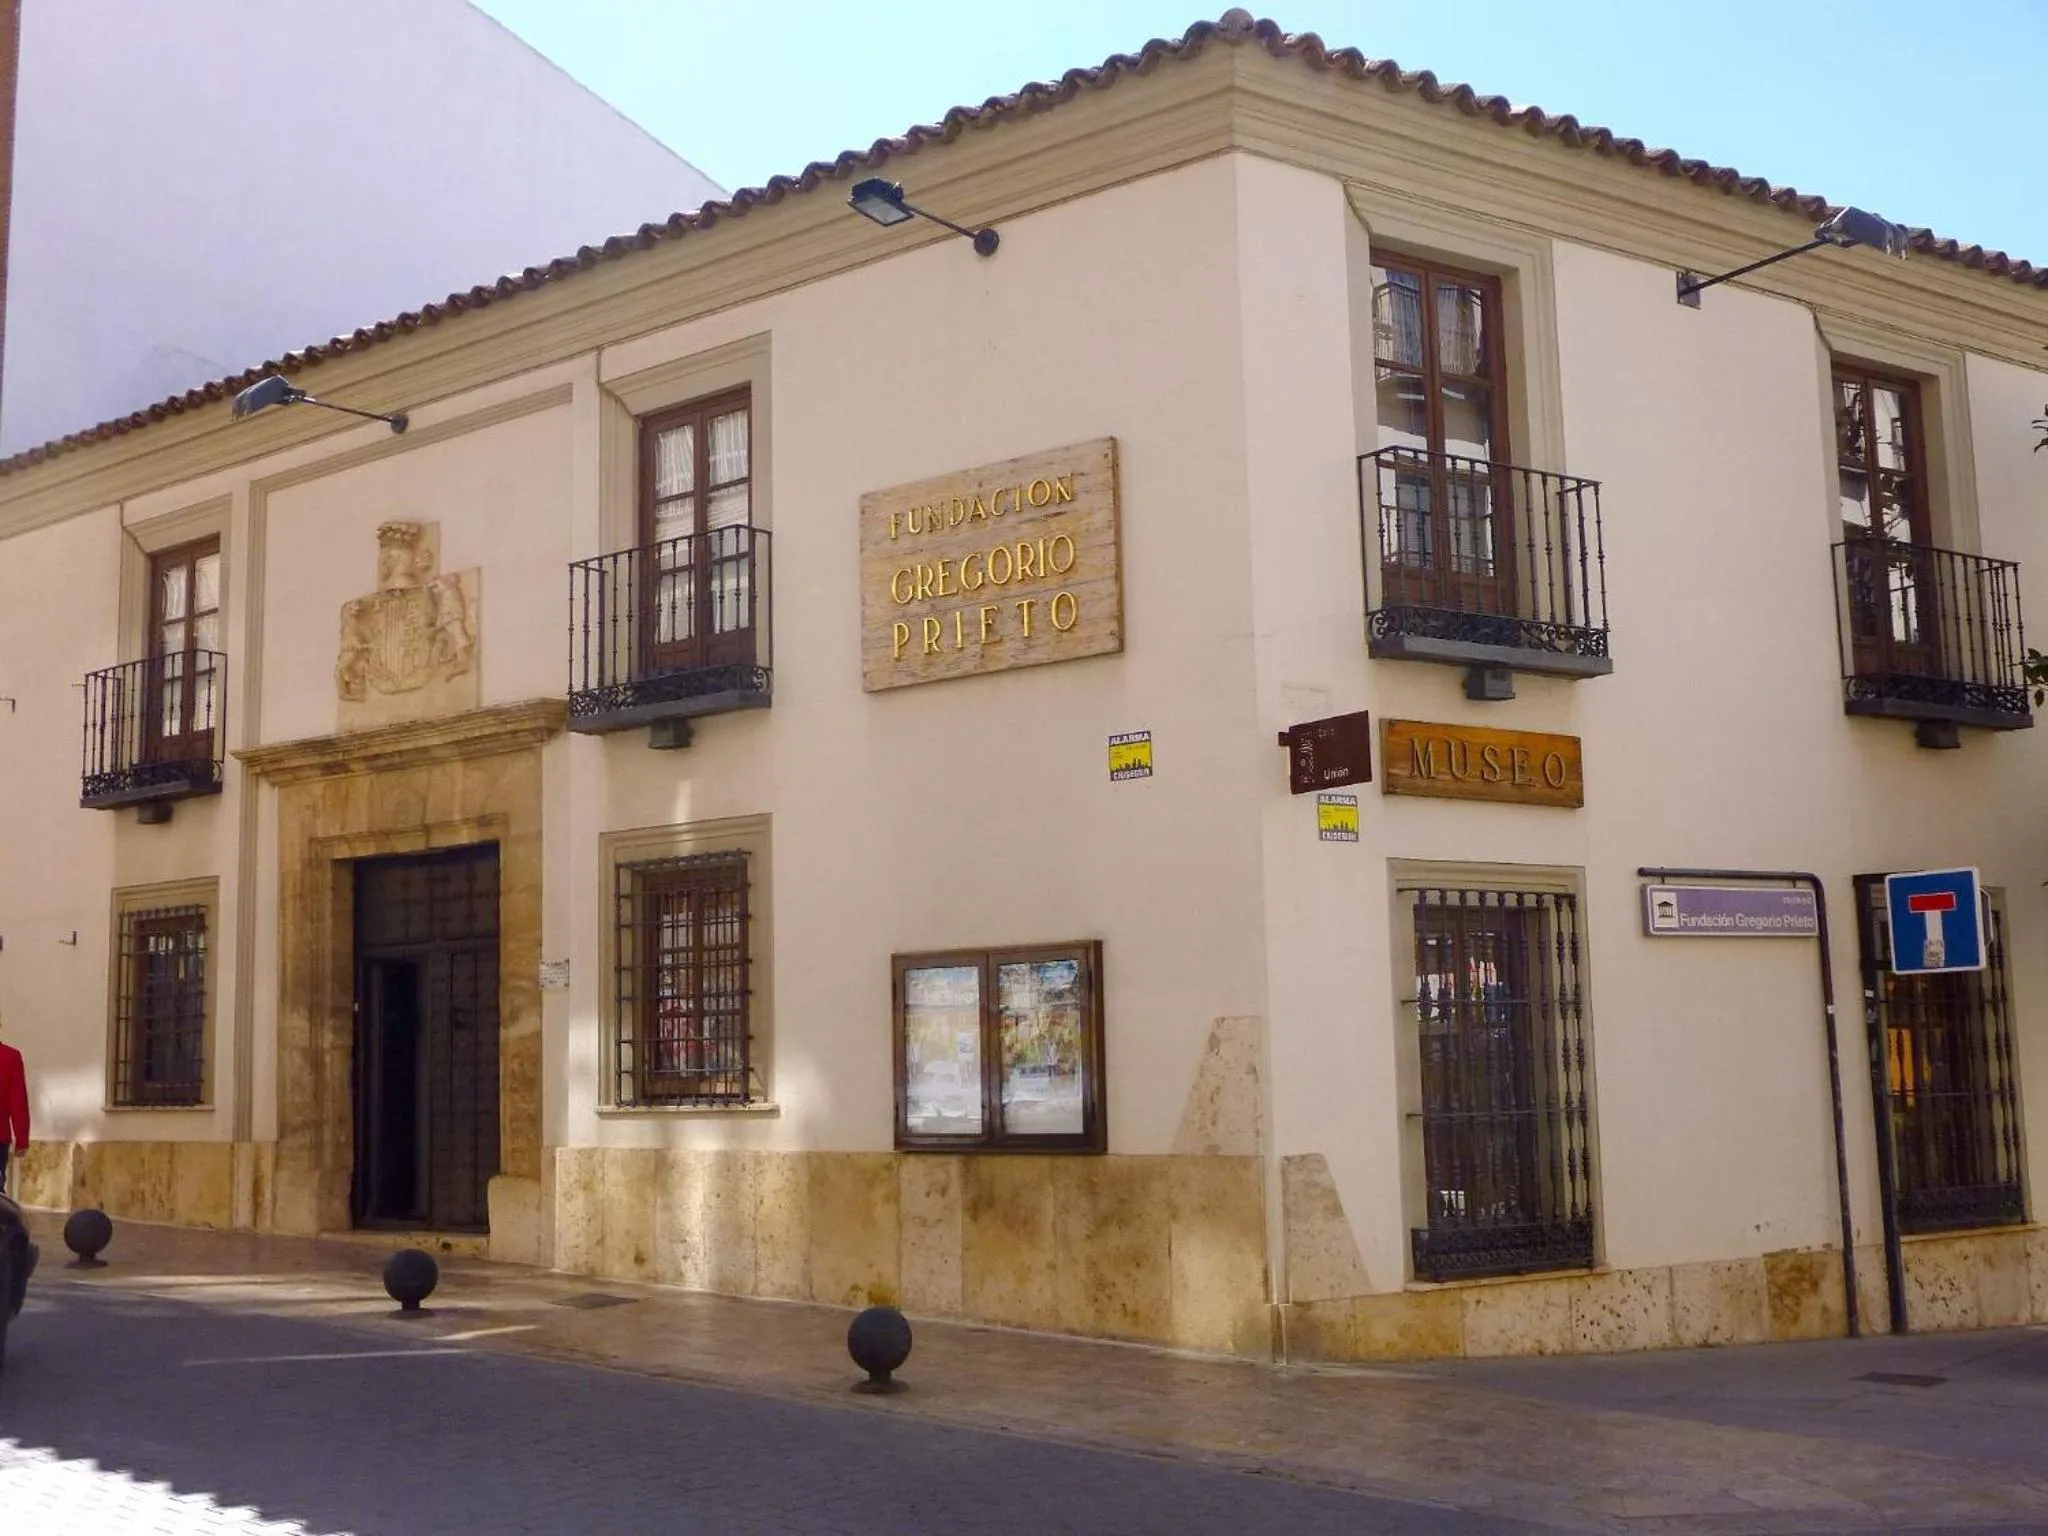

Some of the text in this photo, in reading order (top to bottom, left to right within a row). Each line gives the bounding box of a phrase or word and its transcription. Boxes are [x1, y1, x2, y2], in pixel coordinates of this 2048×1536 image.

[890, 473, 1074, 539] FUNDACION
[891, 534, 1077, 604] GREGORIO
[893, 591, 1078, 659] PRIETO
[1110, 732, 1149, 745] ALARMA
[1410, 737, 1567, 788] MUSEO
[1319, 795, 1357, 805] ALARMA
[1680, 912, 1814, 929] Fundación Gregorio Prieto
